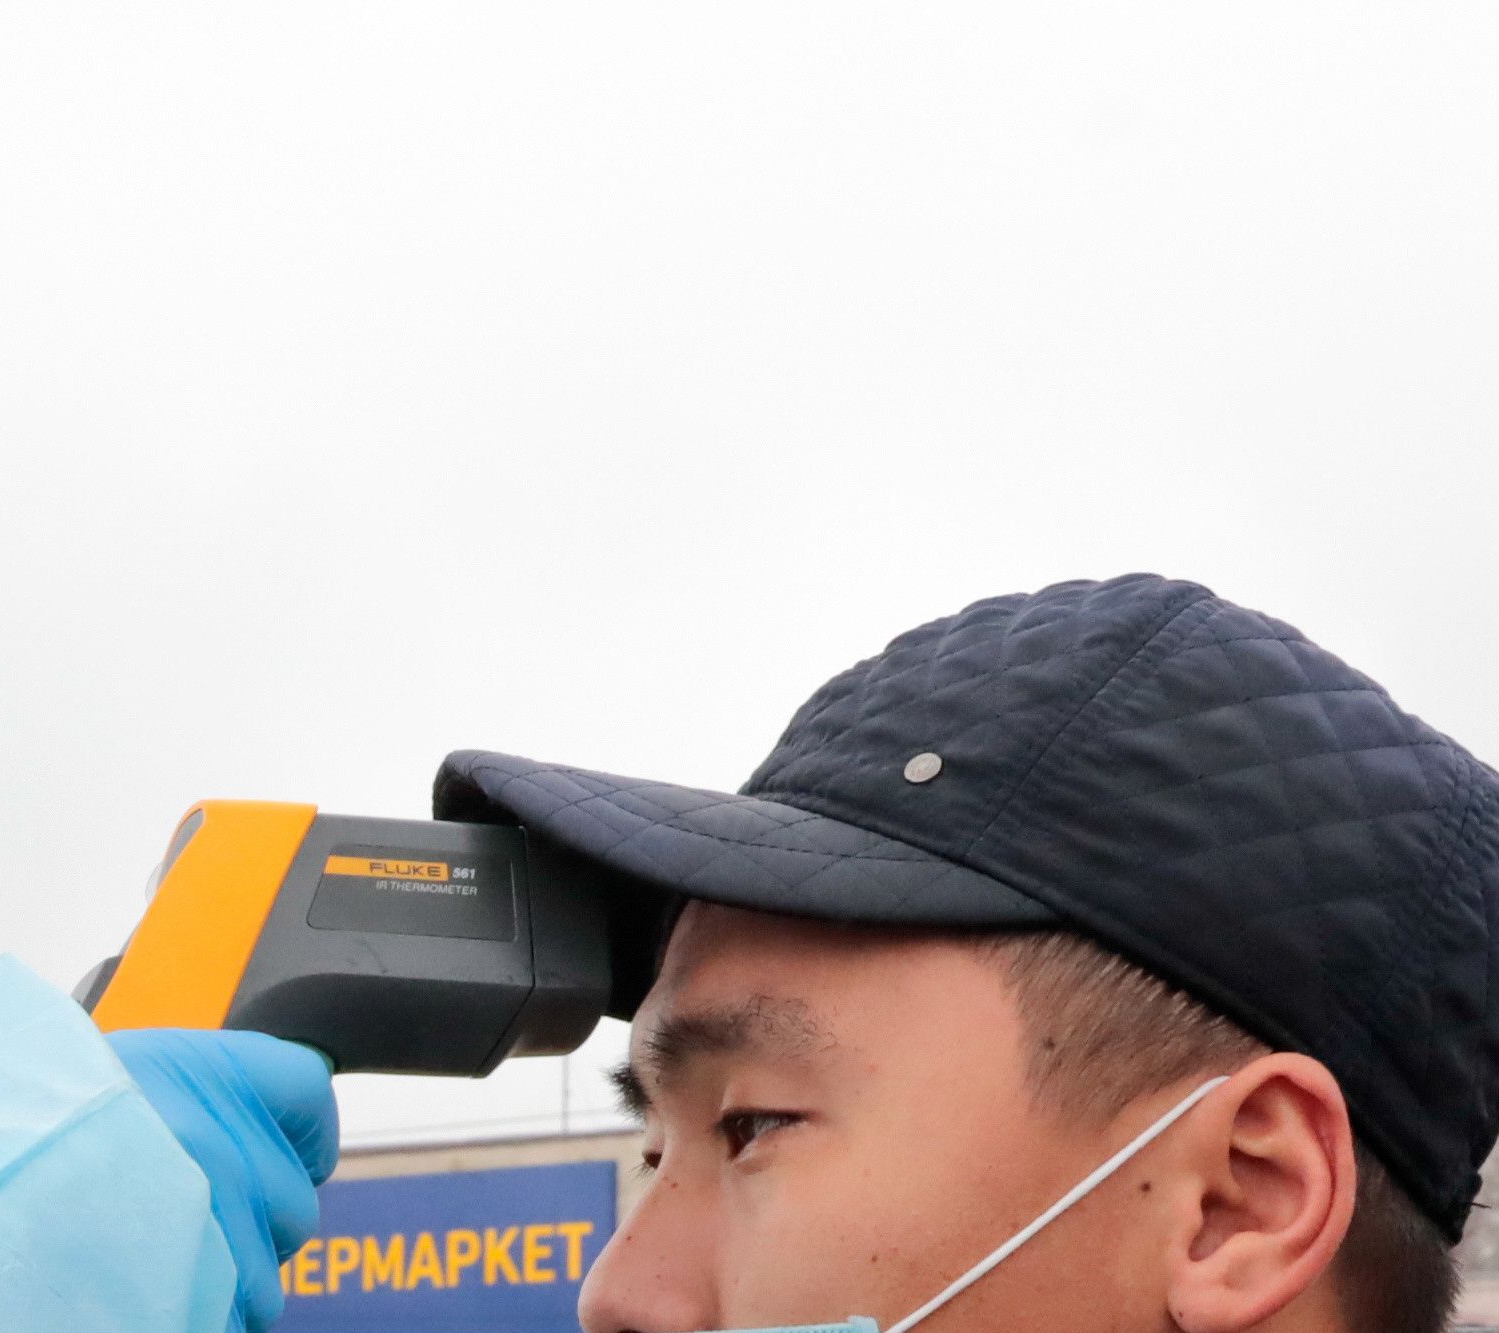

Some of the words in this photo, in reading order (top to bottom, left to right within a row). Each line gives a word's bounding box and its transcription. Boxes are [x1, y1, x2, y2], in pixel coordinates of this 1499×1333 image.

[370, 862, 441, 877] FLUKE
[452, 867, 476, 879] 561
[376, 880, 387, 889] IR
[390, 882, 478, 895] THERMOMETER
[279, 1221, 594, 1296] ЕРМАРКЕТ
